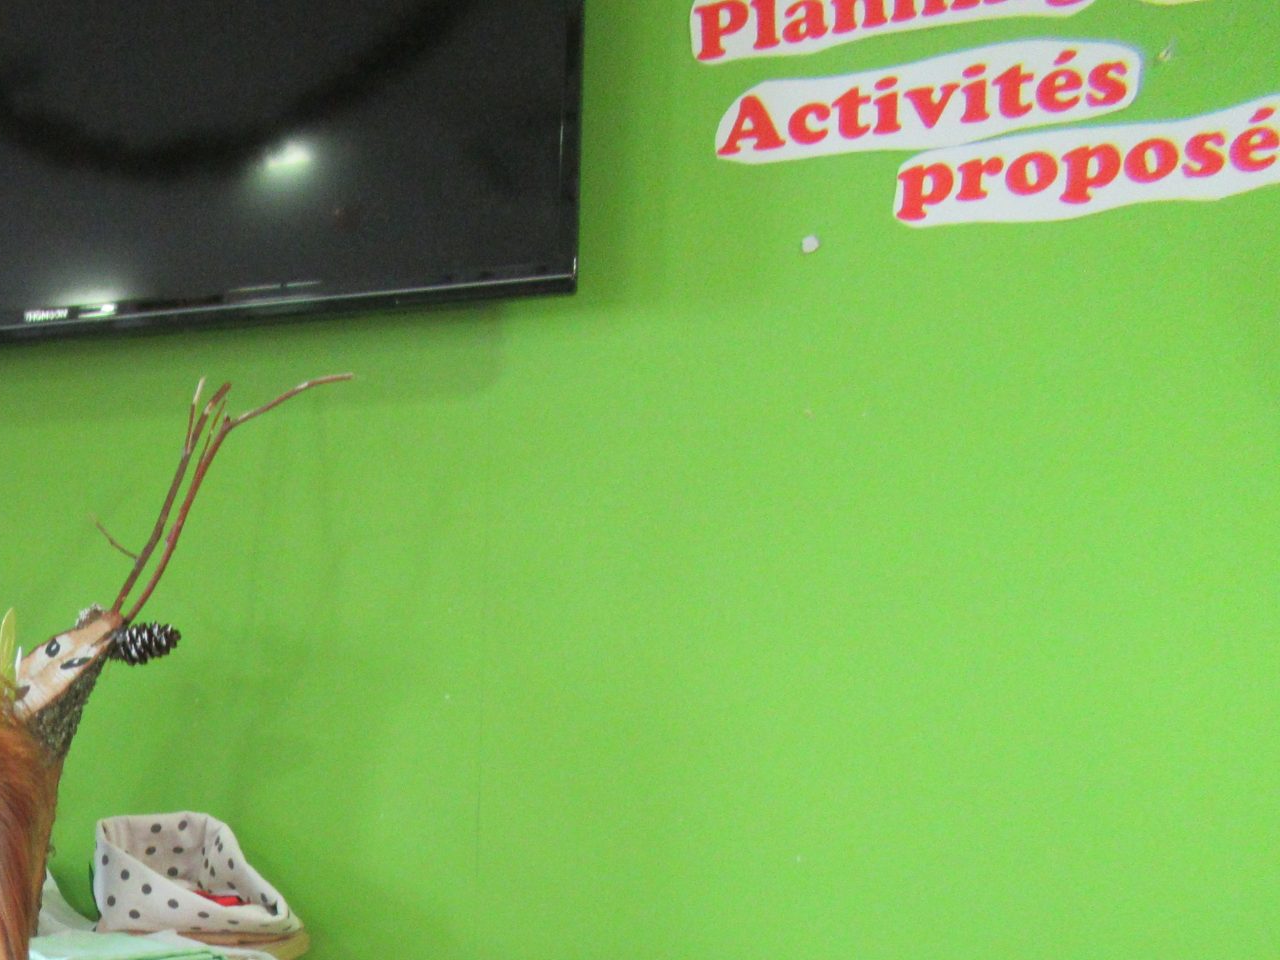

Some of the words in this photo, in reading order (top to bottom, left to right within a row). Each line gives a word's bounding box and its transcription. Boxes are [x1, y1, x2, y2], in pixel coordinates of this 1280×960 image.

[694, 0, 1083, 61] Plan
[717, 49, 1129, 156] Activités
[895, 107, 1280, 222] proposé
